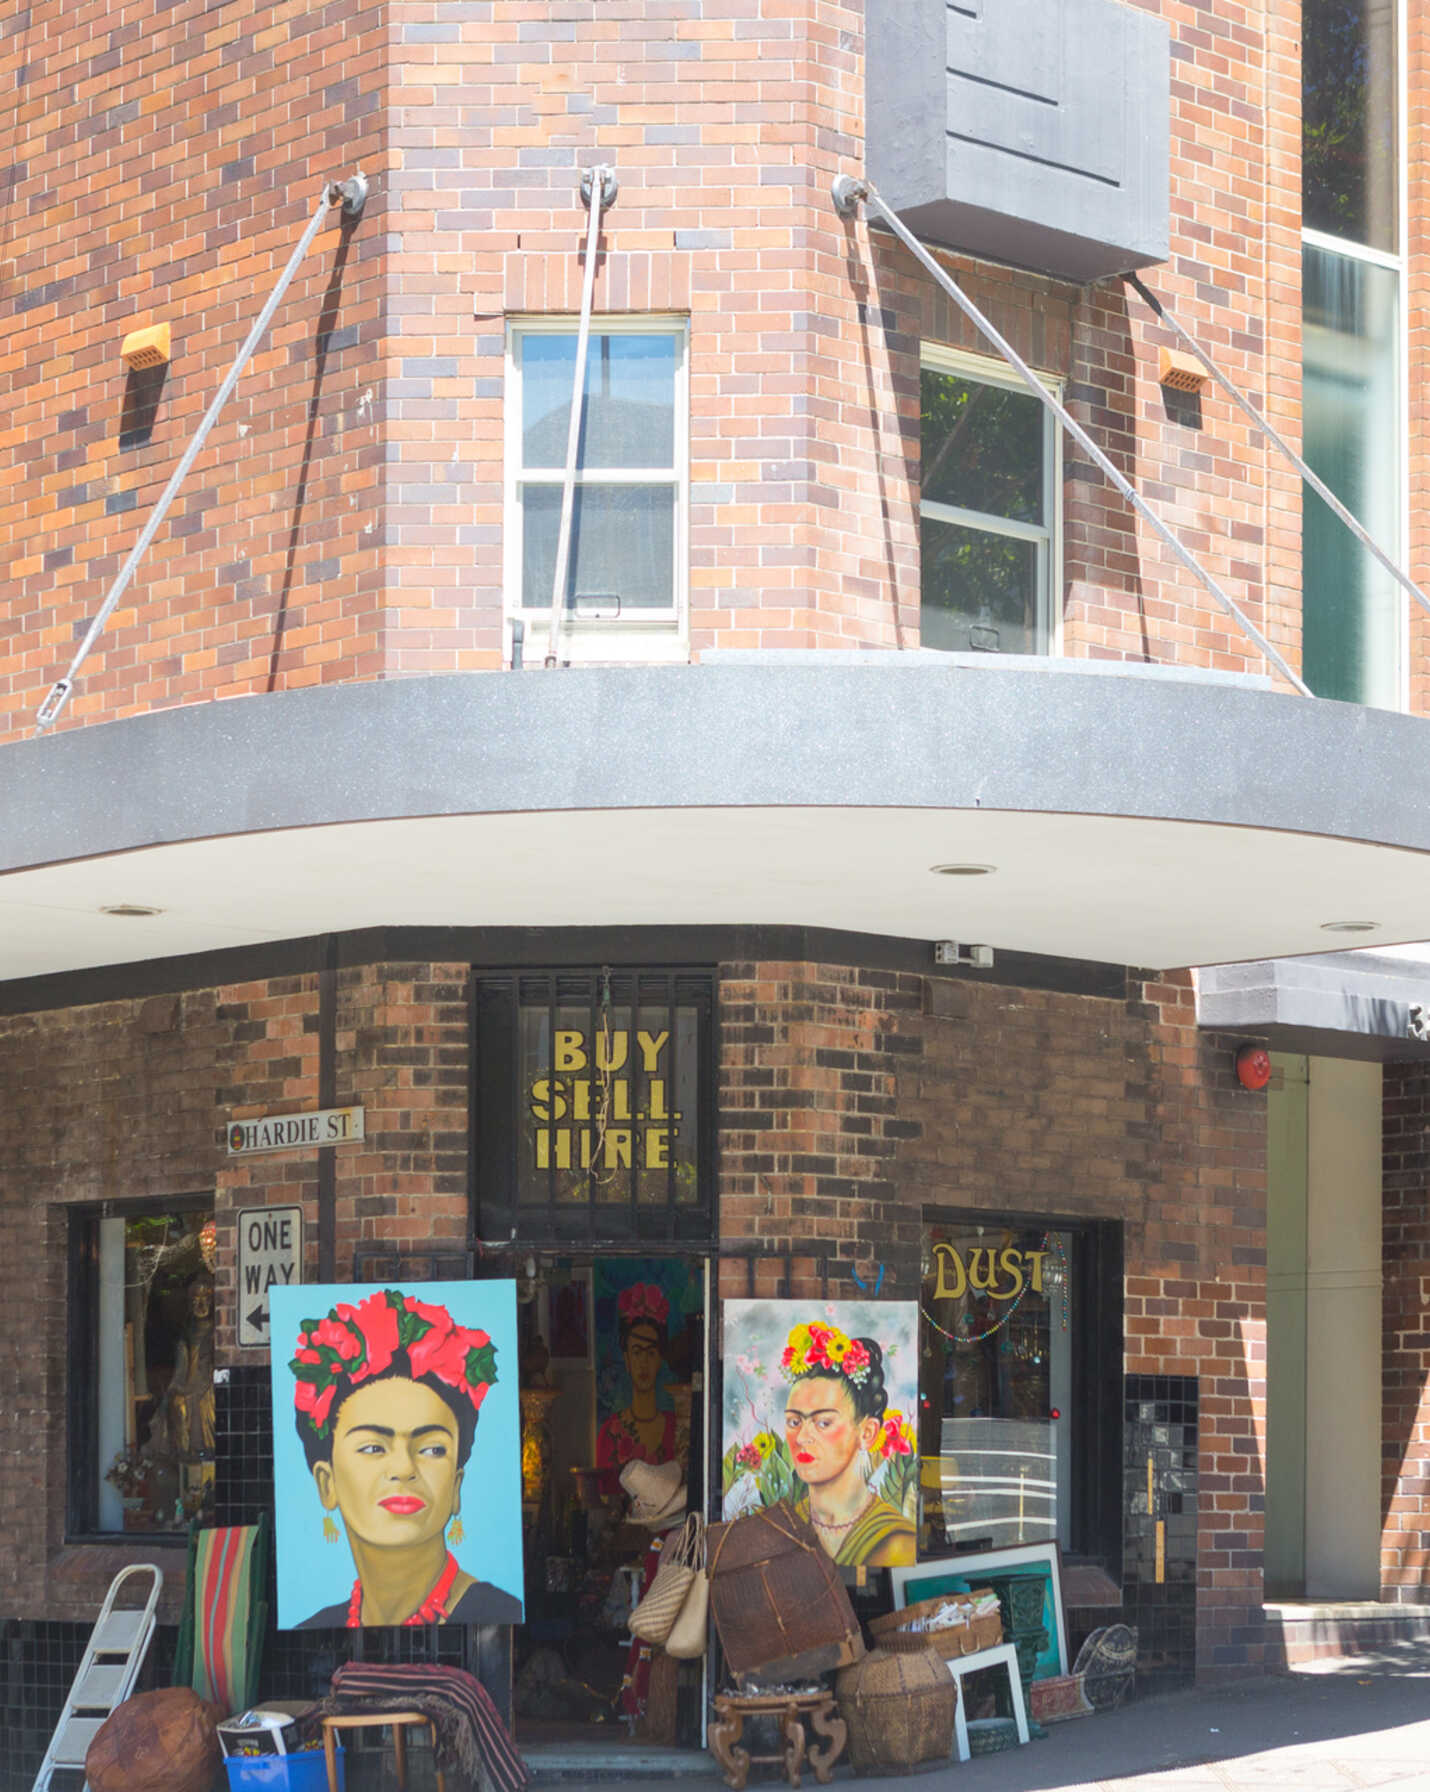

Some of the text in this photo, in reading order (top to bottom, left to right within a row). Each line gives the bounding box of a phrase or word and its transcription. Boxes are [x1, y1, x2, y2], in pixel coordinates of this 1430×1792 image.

[553, 1030, 670, 1072] BUY
[531, 1079, 683, 1120] SELL
[244, 1112, 350, 1149] HARDIE ST
[536, 1128, 679, 1169] HIRE
[249, 1220, 292, 1251] ONE
[245, 1262, 295, 1294] WAY
[932, 1243, 1049, 1300] DUST
